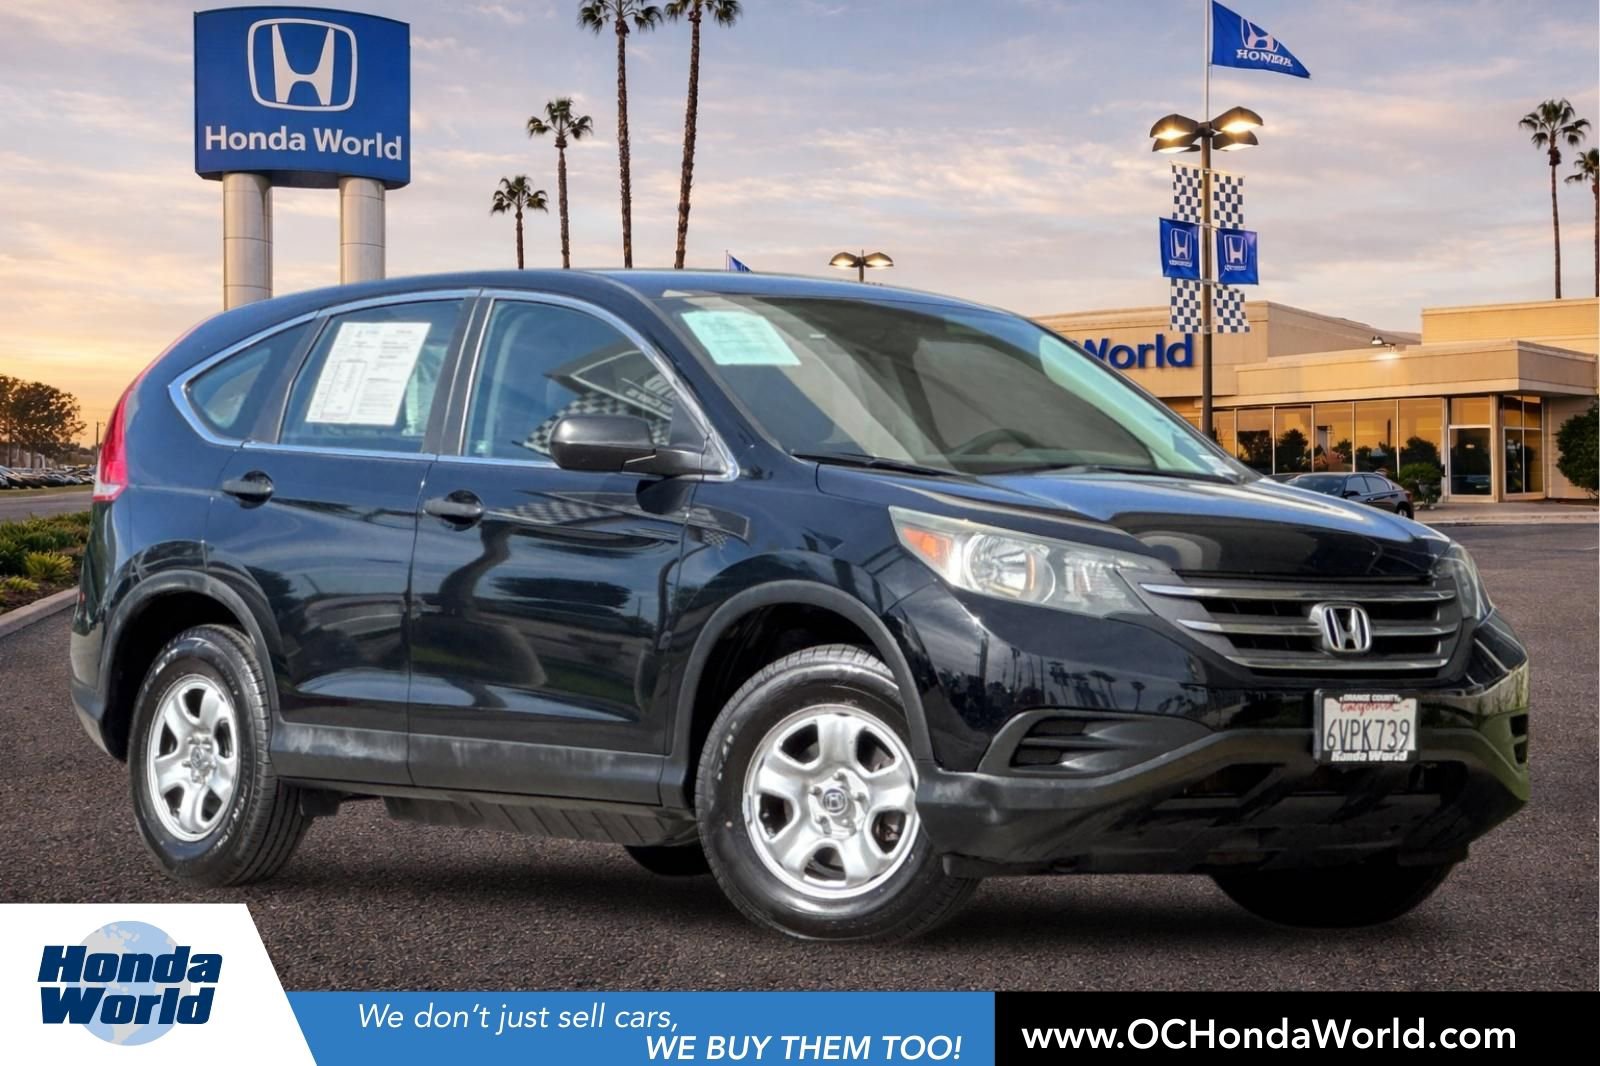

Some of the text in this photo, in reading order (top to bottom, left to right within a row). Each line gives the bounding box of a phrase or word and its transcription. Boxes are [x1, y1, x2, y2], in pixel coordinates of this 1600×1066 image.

[205, 125, 402, 160] Honda World
[1326, 718, 1410, 751] 6VPK739
[1331, 750, 1409, 762] Honda World
